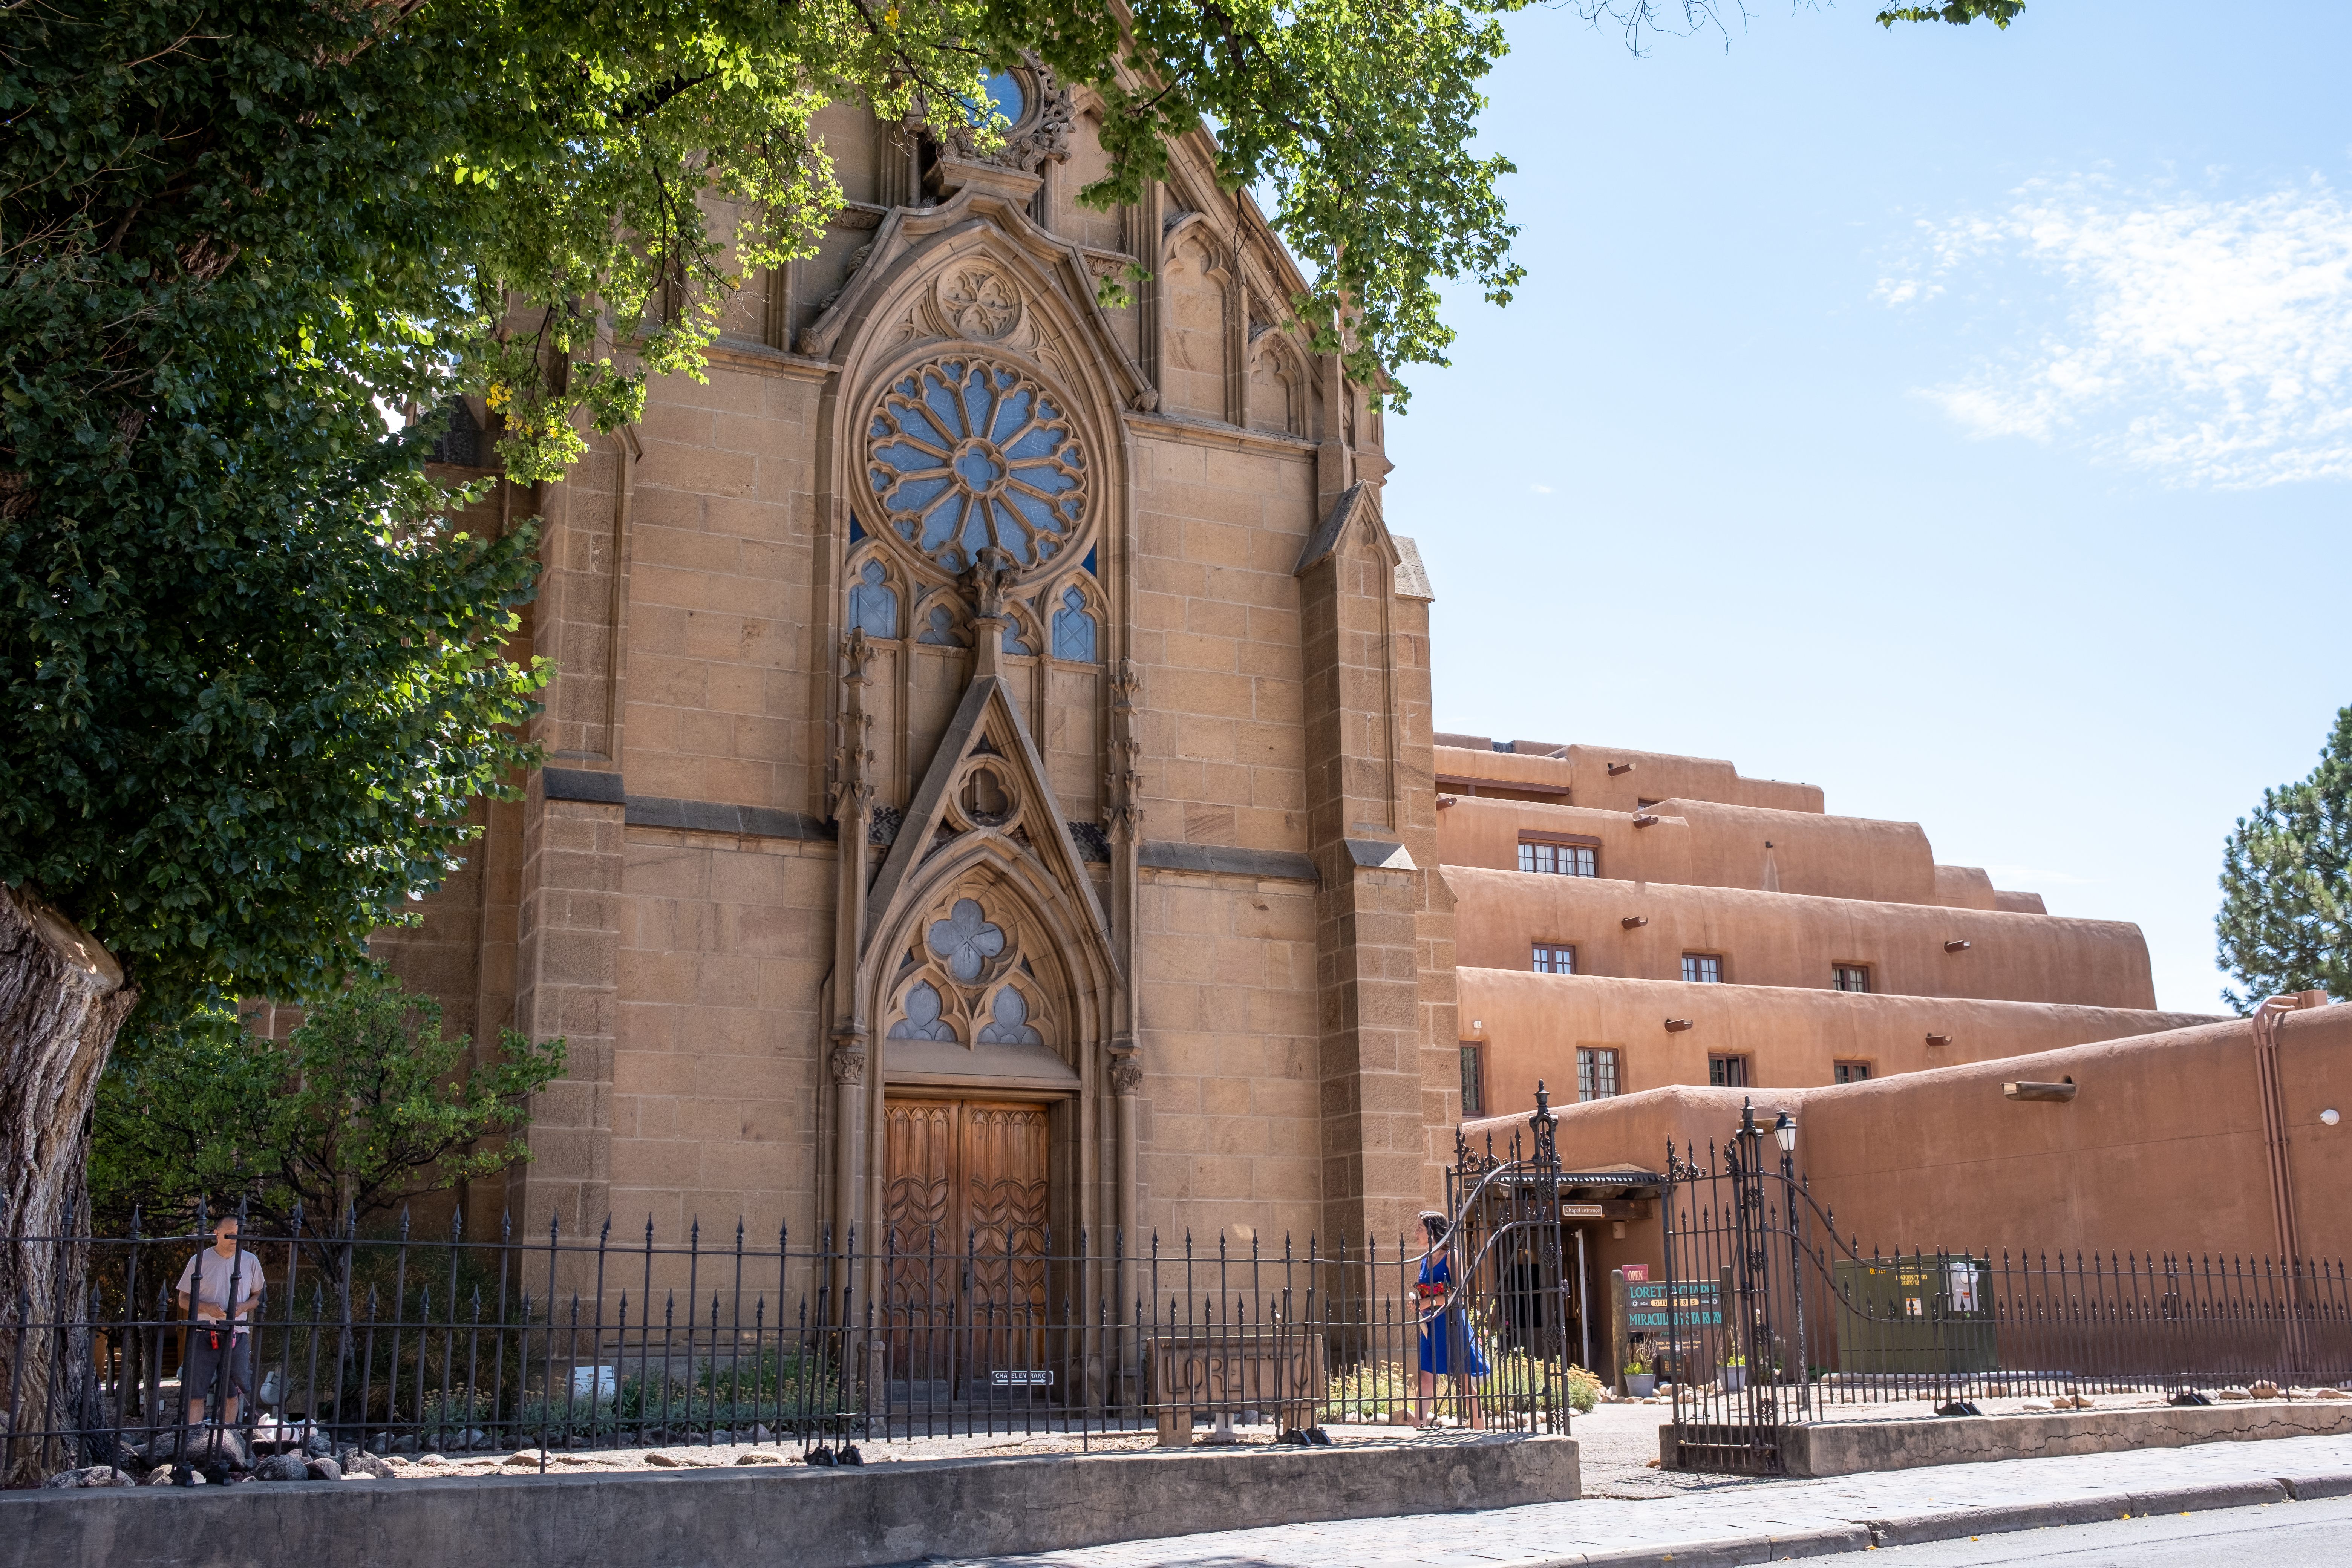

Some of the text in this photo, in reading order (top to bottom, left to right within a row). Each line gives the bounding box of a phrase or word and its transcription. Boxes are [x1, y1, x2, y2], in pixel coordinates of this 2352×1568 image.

[1628, 1270, 1643, 1281] OPEN
[1629, 1311, 1721, 1326] MIRACULUS STARWAY
[1165, 1354, 1312, 1393] LORETTO
